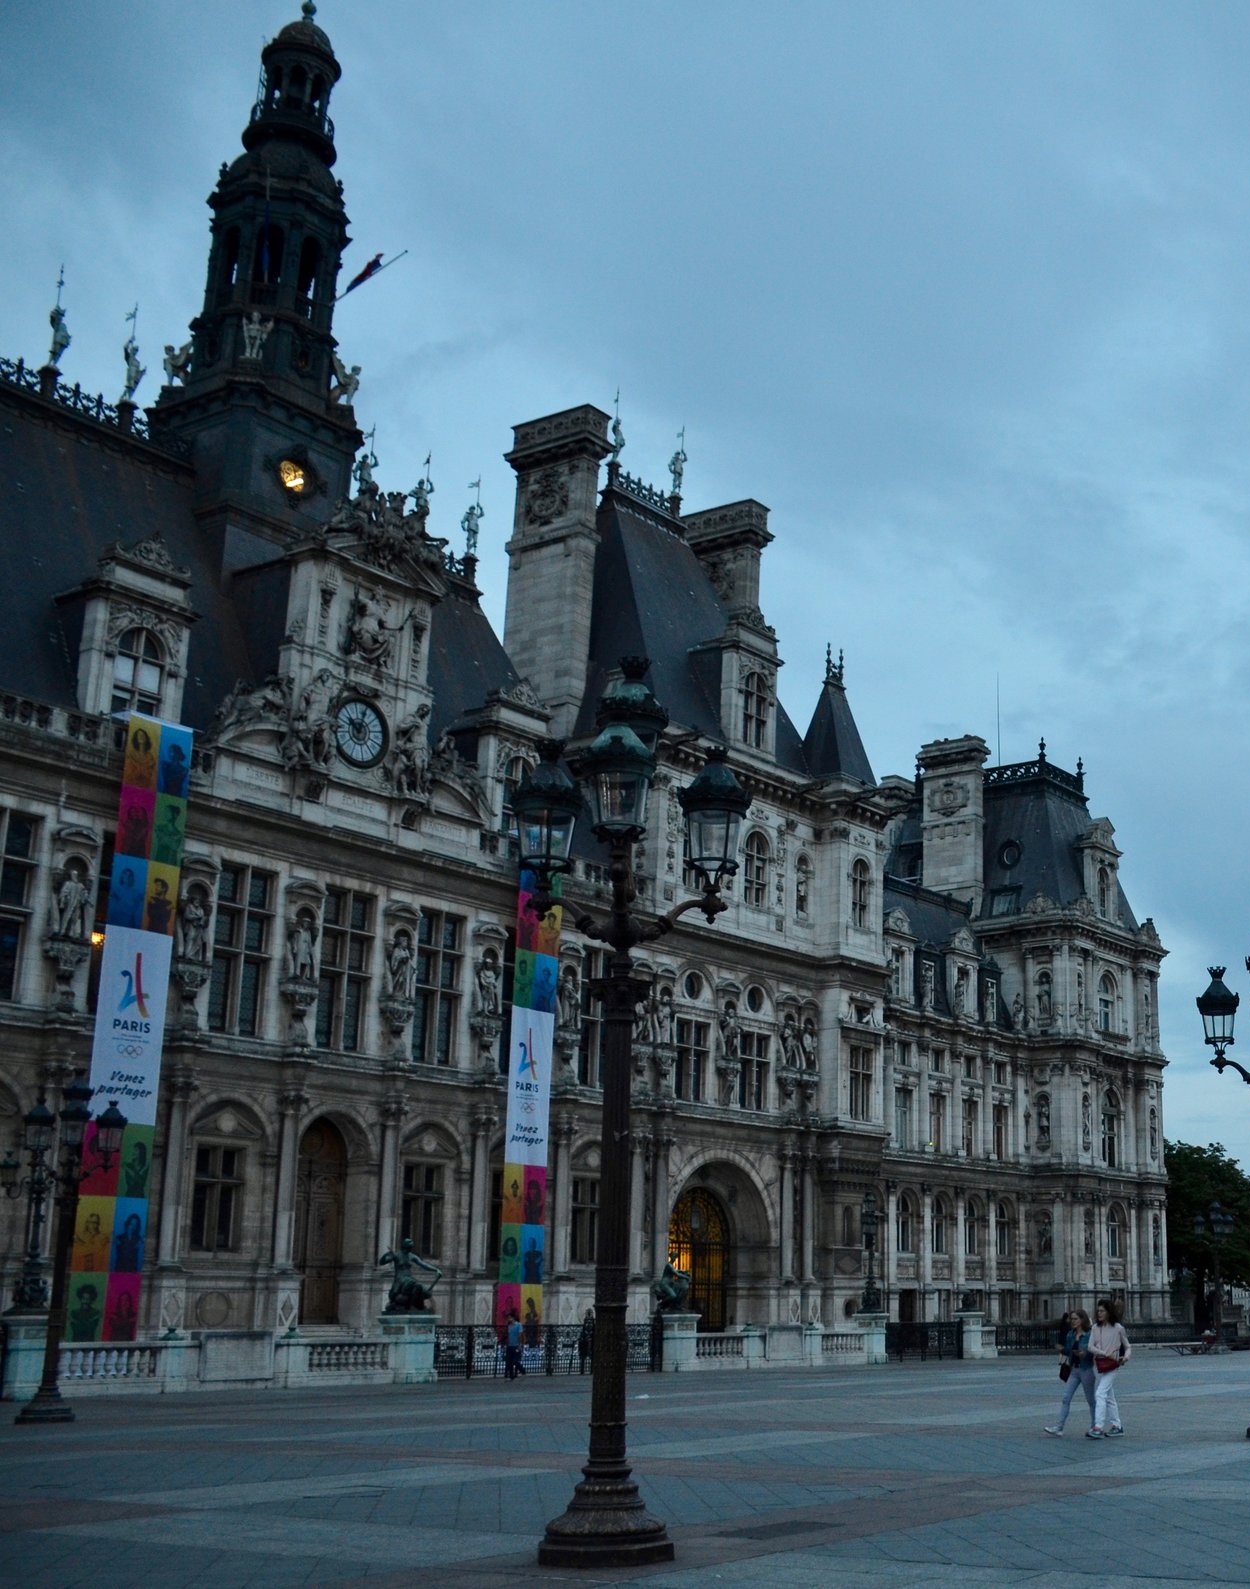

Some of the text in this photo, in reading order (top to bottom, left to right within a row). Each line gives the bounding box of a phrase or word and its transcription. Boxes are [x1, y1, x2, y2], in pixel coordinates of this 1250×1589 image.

[112, 1018, 151, 1034] PARIS
[110, 1070, 146, 1084] Venez
[95, 1084, 153, 1100] partager
[515, 1081, 539, 1093] PARIS
